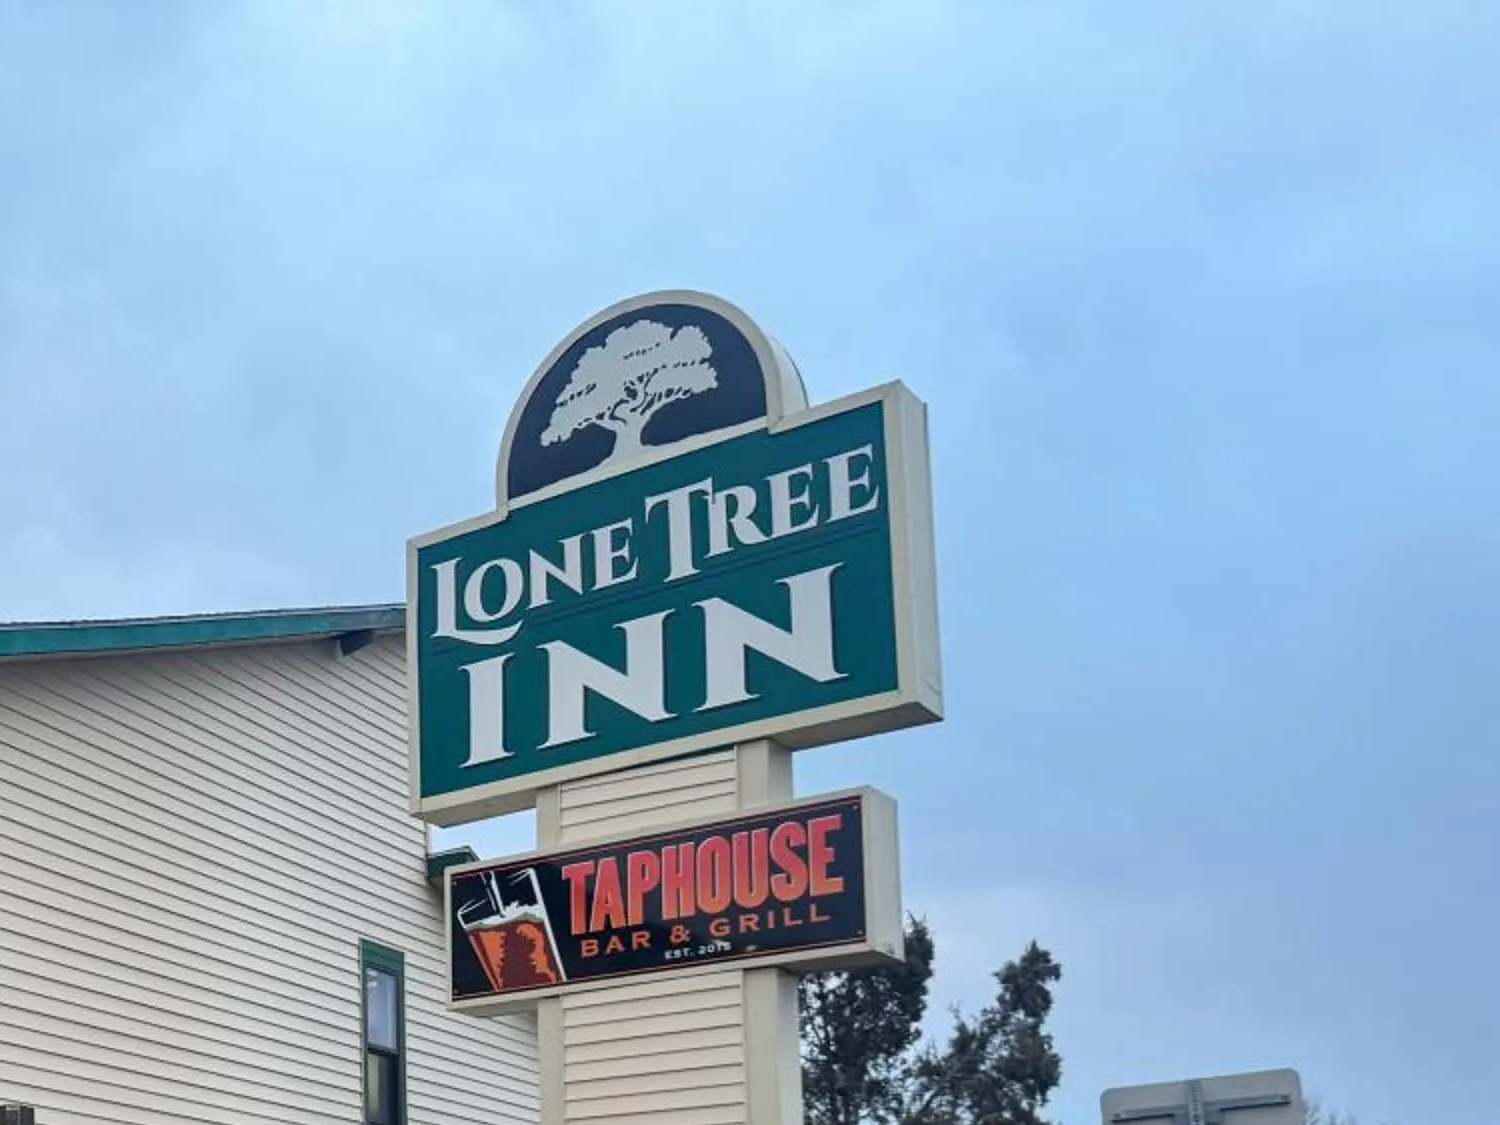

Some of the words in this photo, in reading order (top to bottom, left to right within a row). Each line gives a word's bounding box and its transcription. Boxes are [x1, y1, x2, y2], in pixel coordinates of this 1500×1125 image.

[430, 517, 640, 646] LONE
[645, 443, 880, 584] TREE
[459, 563, 850, 769] INN
[562, 813, 845, 936] TAPHOUSE
[580, 930, 651, 959] BAR
[669, 924, 691, 945] &
[709, 902, 832, 938] GRILL
[664, 947, 694, 960] EST.
